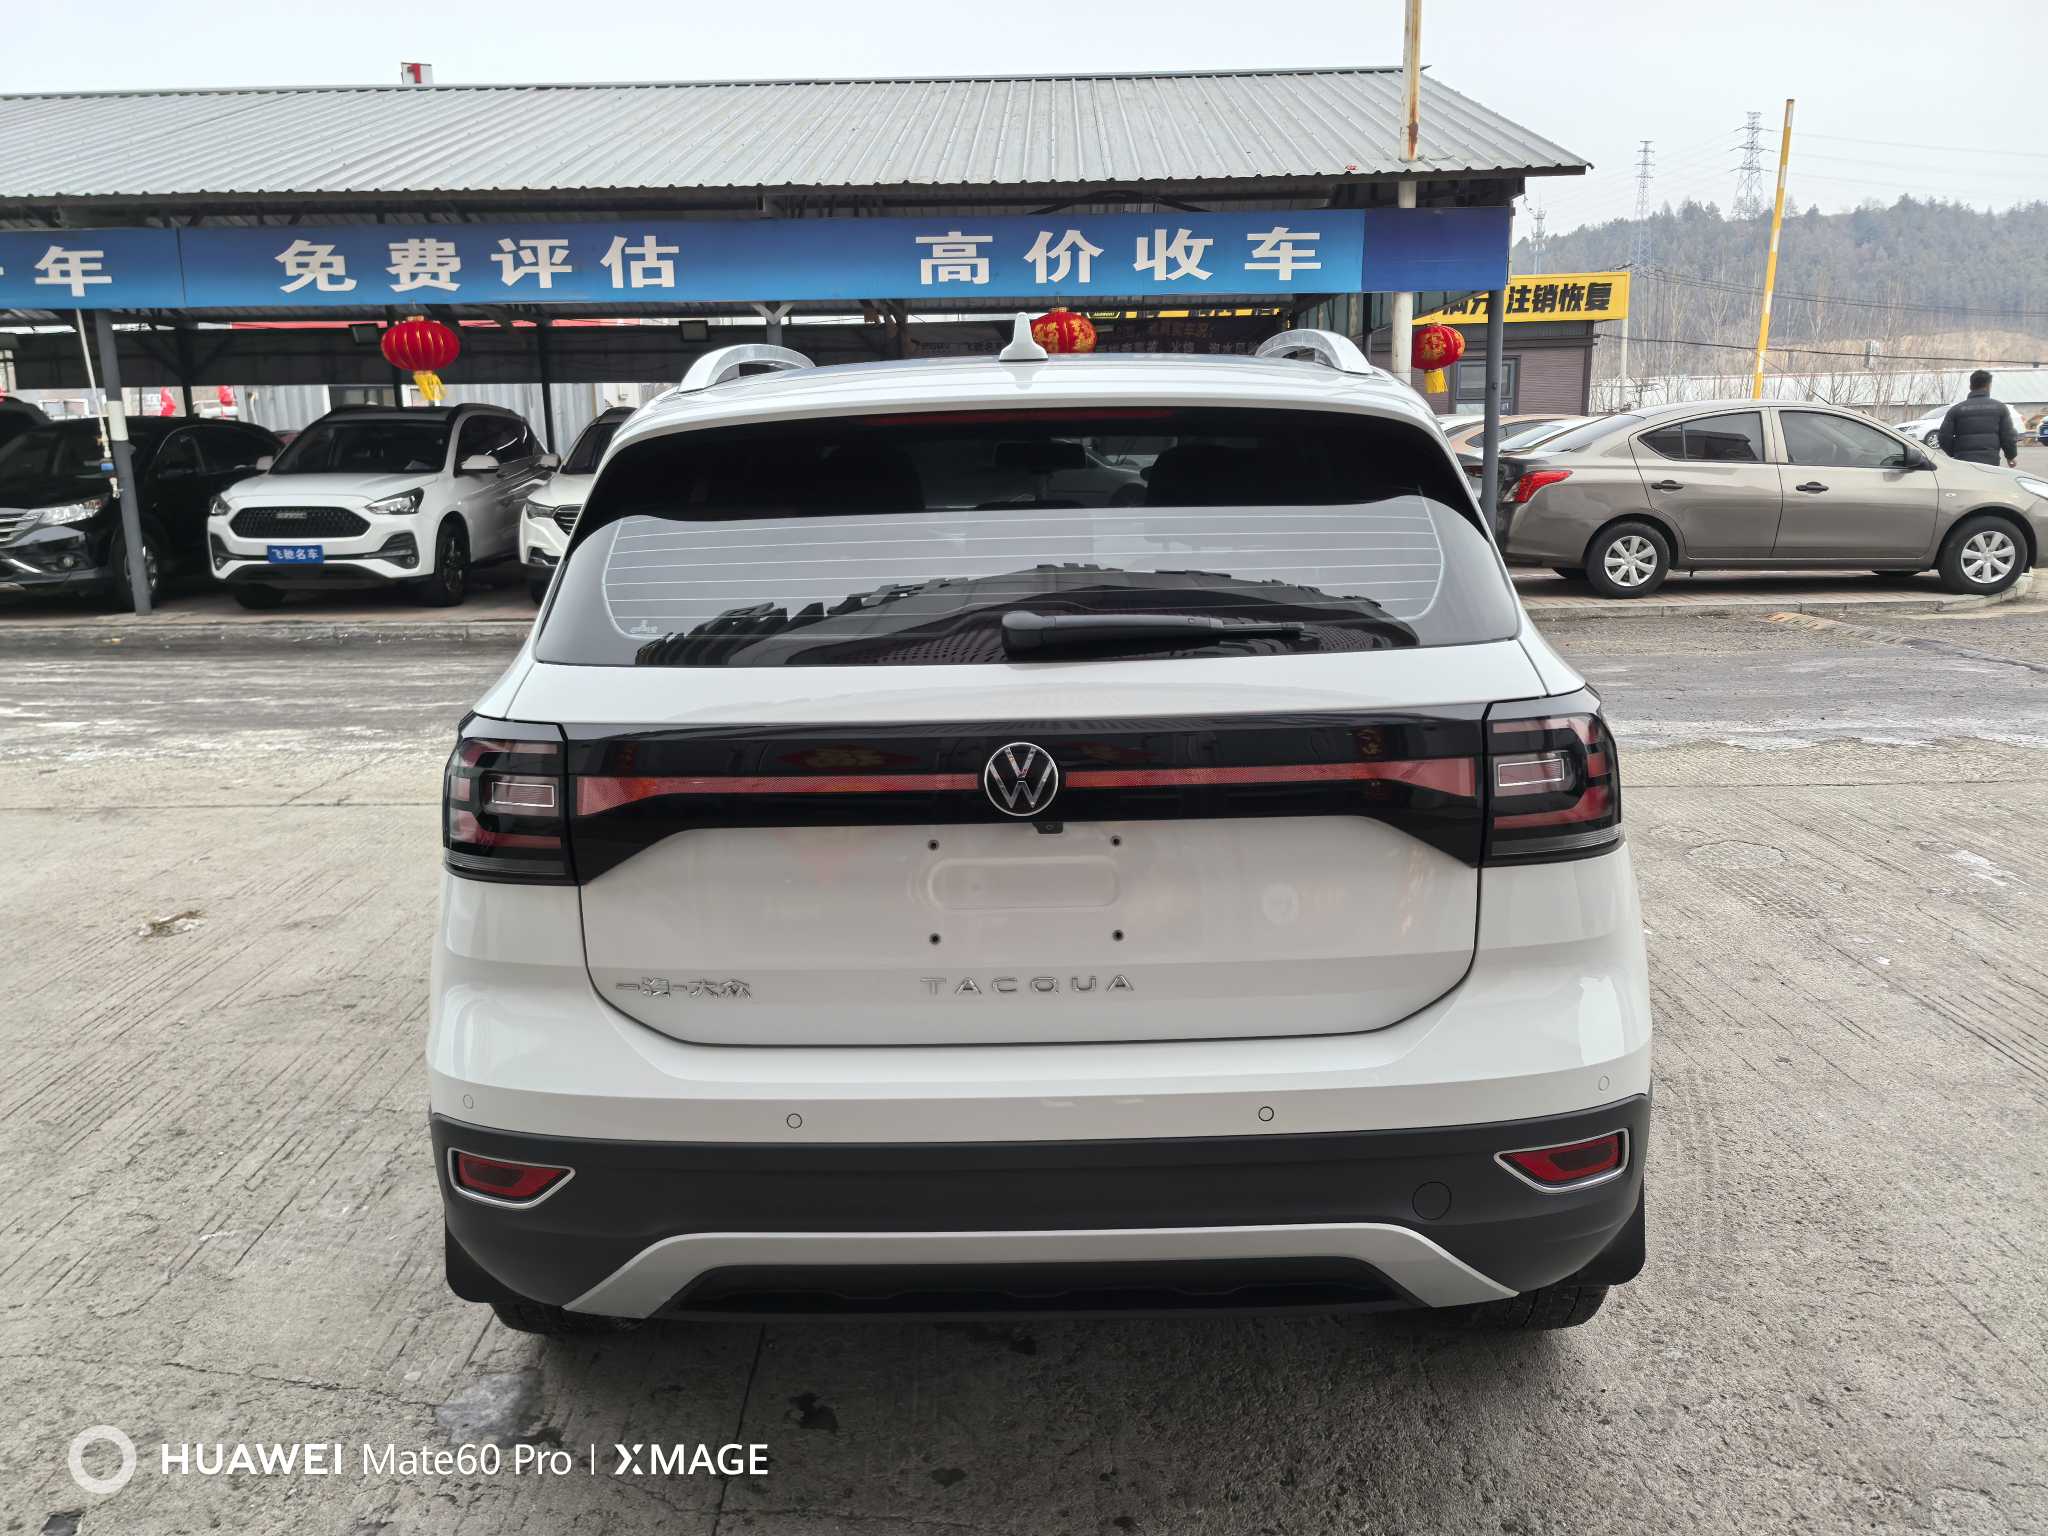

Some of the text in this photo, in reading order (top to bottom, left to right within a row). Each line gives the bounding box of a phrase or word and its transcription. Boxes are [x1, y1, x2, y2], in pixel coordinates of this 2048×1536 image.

[0, 226, 1322, 296] 年 免费评估 高价收车
[1505, 282, 1613, 314] 注销恢复
[271, 548, 319, 560] 飞驰名车
[920, 974, 1135, 996] TACQUA
